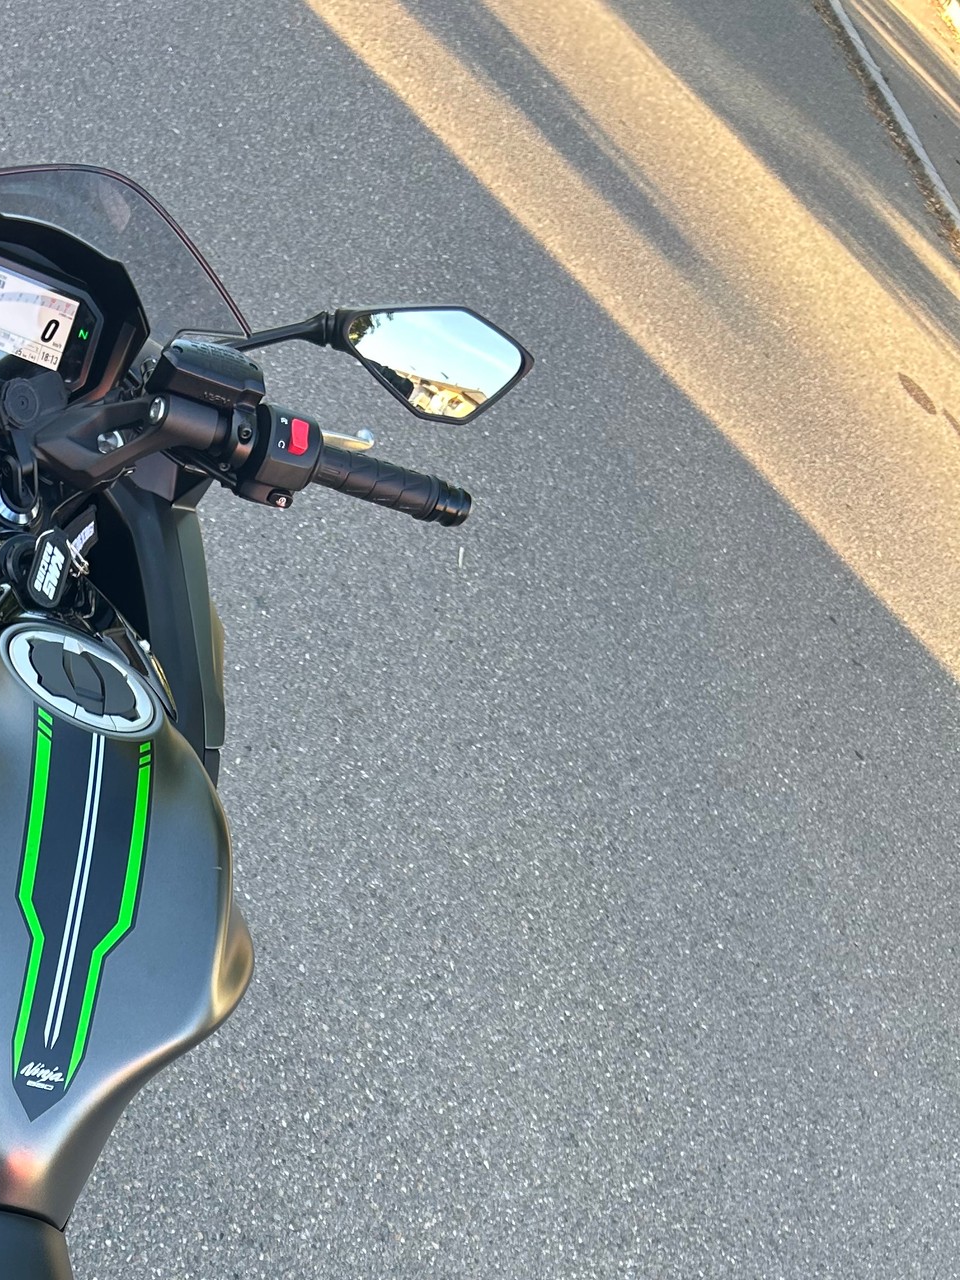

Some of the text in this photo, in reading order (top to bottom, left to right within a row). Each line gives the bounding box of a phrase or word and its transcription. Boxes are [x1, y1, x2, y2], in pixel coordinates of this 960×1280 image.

[40, 318, 60, 343] 0
[78, 329, 89, 340] N
[40, 351, 59, 366] 18:13
[20, 1061, 65, 1083] Ninja
